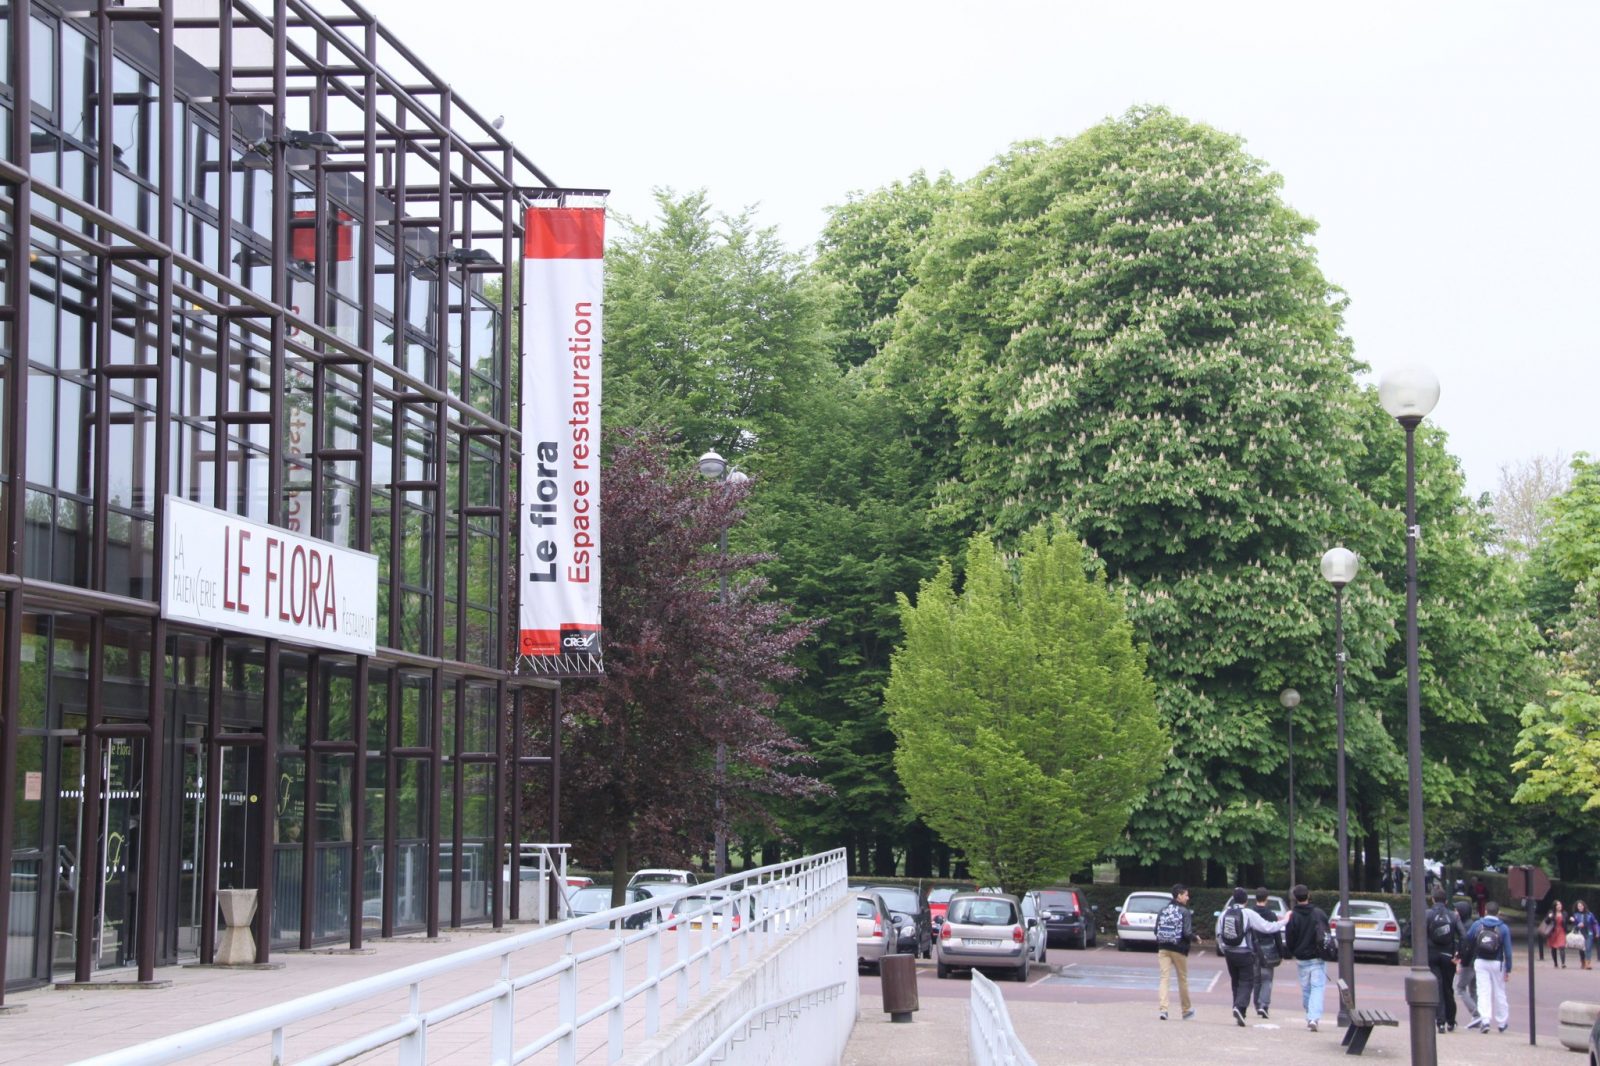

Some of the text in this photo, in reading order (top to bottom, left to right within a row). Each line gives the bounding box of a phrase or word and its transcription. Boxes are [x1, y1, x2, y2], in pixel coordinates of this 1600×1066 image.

[529, 441, 558, 583] Le flora
[567, 301, 594, 584] Espace restauration
[223, 525, 337, 633] LE FLORA
